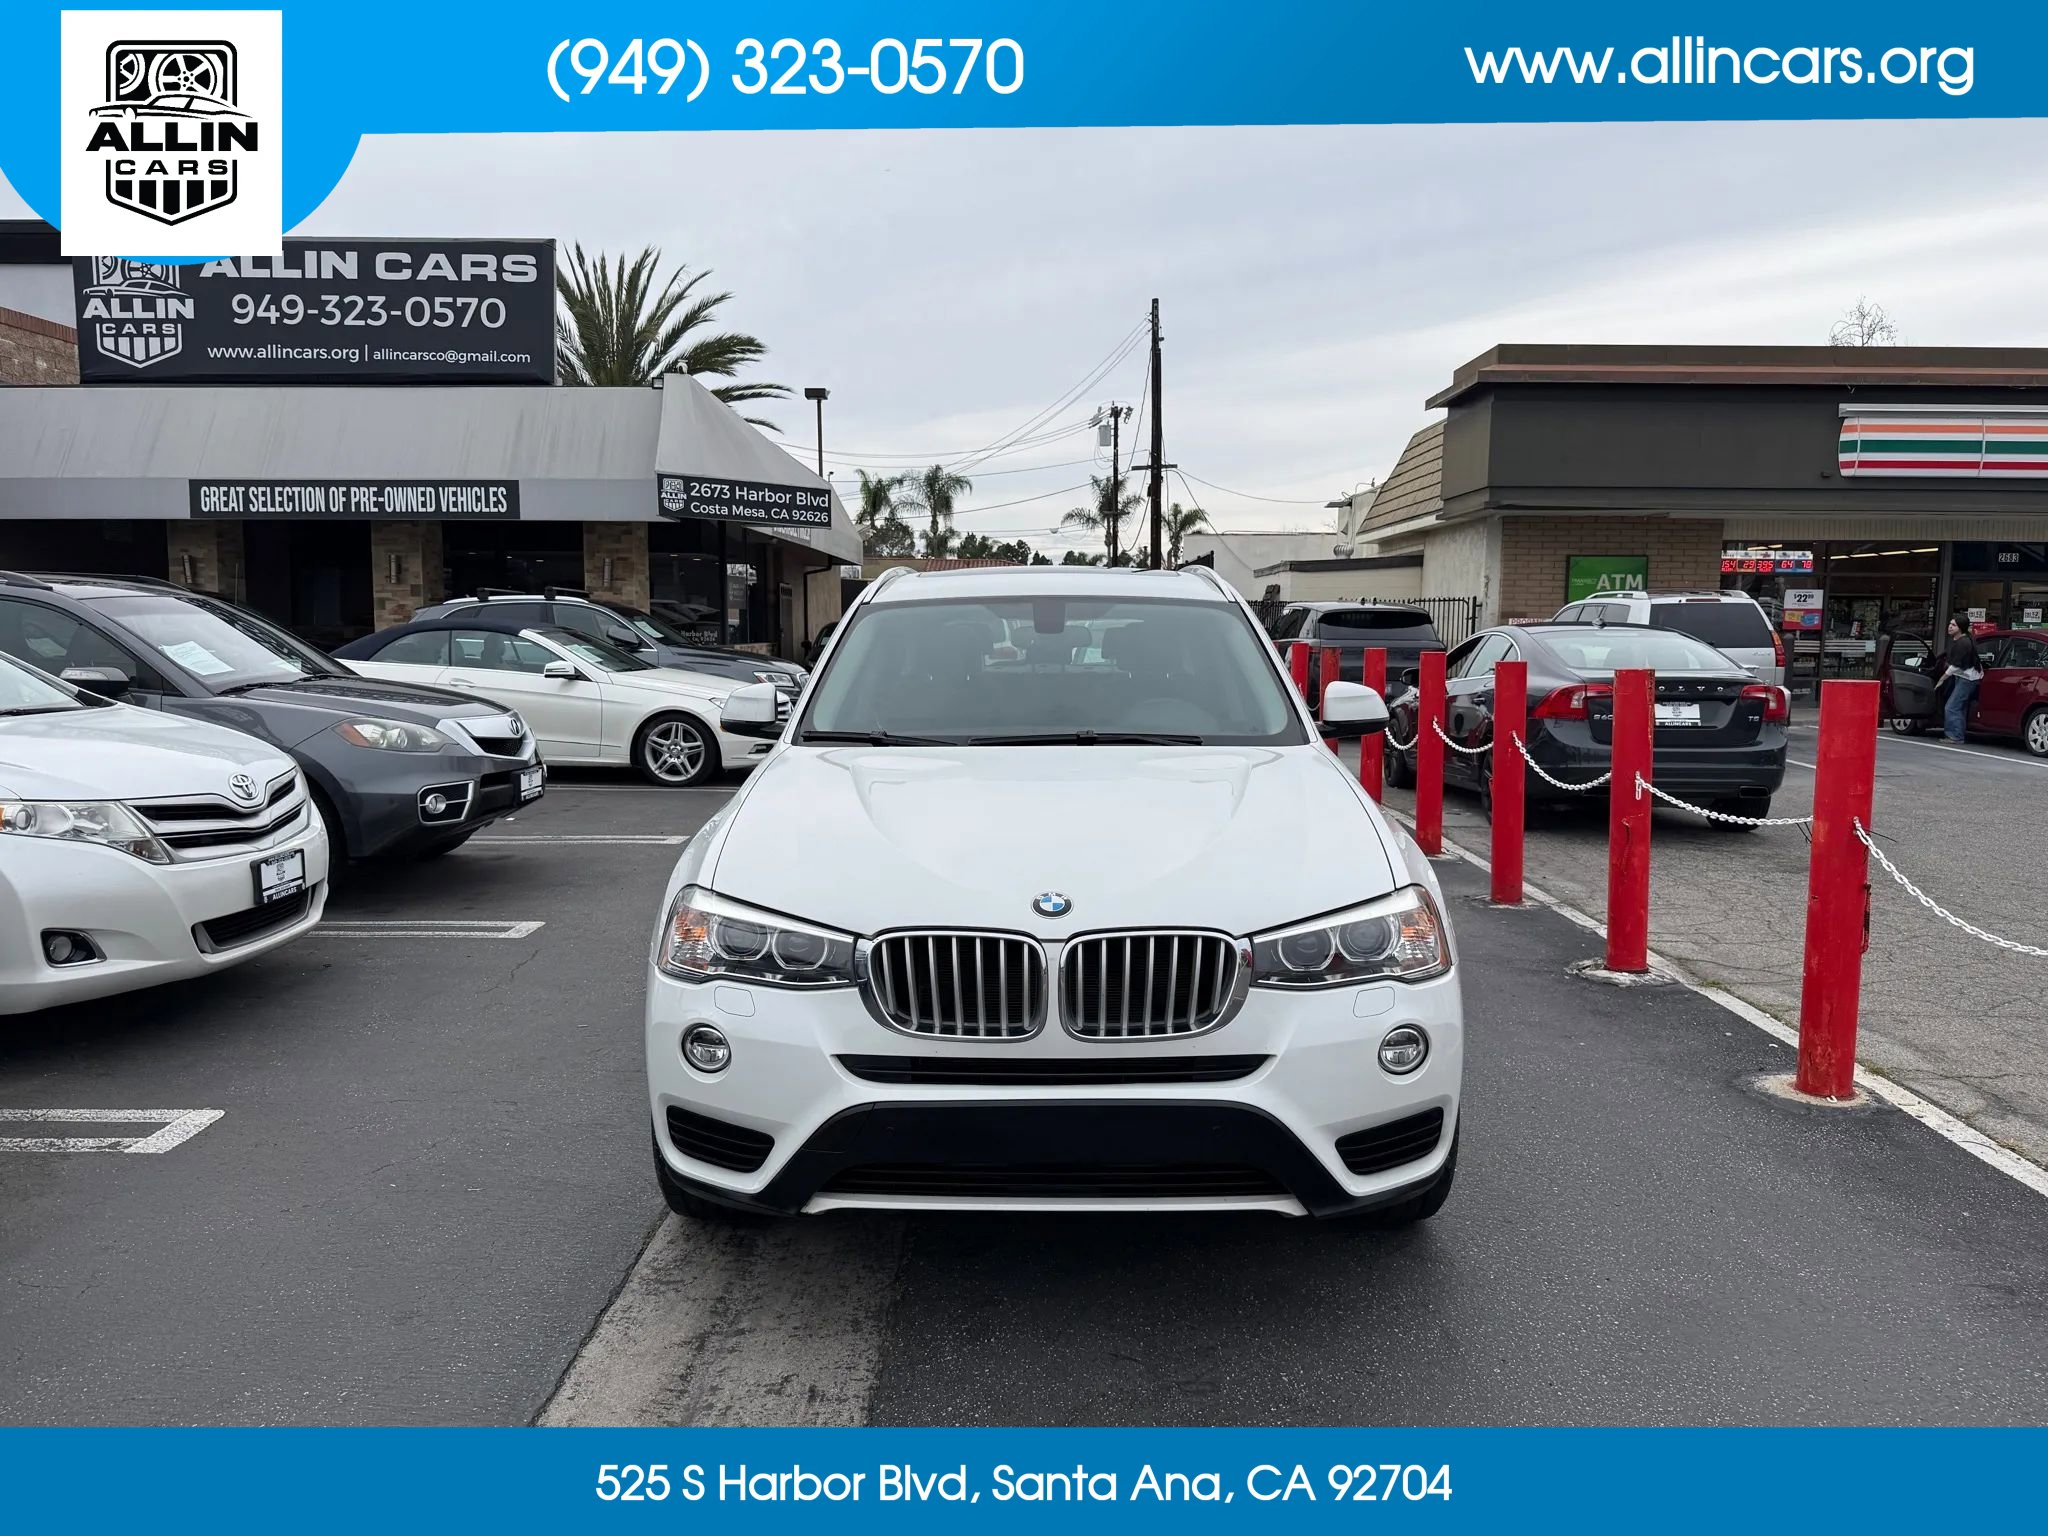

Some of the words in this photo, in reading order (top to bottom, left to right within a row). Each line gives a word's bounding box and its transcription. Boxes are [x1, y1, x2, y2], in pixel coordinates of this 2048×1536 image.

[199, 250, 358, 280] ALLIN
[375, 252, 538, 283] CARS
[82, 297, 195, 319] ALLIN
[231, 294, 507, 329] 949-323-0570
[102, 323, 176, 335] CARS
[207, 344, 360, 363] www.allincars.org
[373, 348, 531, 365] allincarsco@gmail.com
[200, 487, 245, 511] GREAT
[249, 487, 325, 512] SELECTION
[329, 487, 347, 512] OF
[351, 487, 436, 513] PRE-OWNED
[439, 487, 508, 513] VEHICLES
[661, 492, 687, 500] ALLIN
[690, 482, 731, 499] 2673
[735, 486, 792, 504] Harbor
[796, 492, 829, 508] Blvd
[690, 502, 729, 516] Costa
[732, 505, 768, 519] Mesa,
[771, 508, 790, 520] CA
[792, 510, 829, 523] 92626
[1596, 573, 1643, 590] ATM
[272, 886, 297, 901] ALLINCARS
